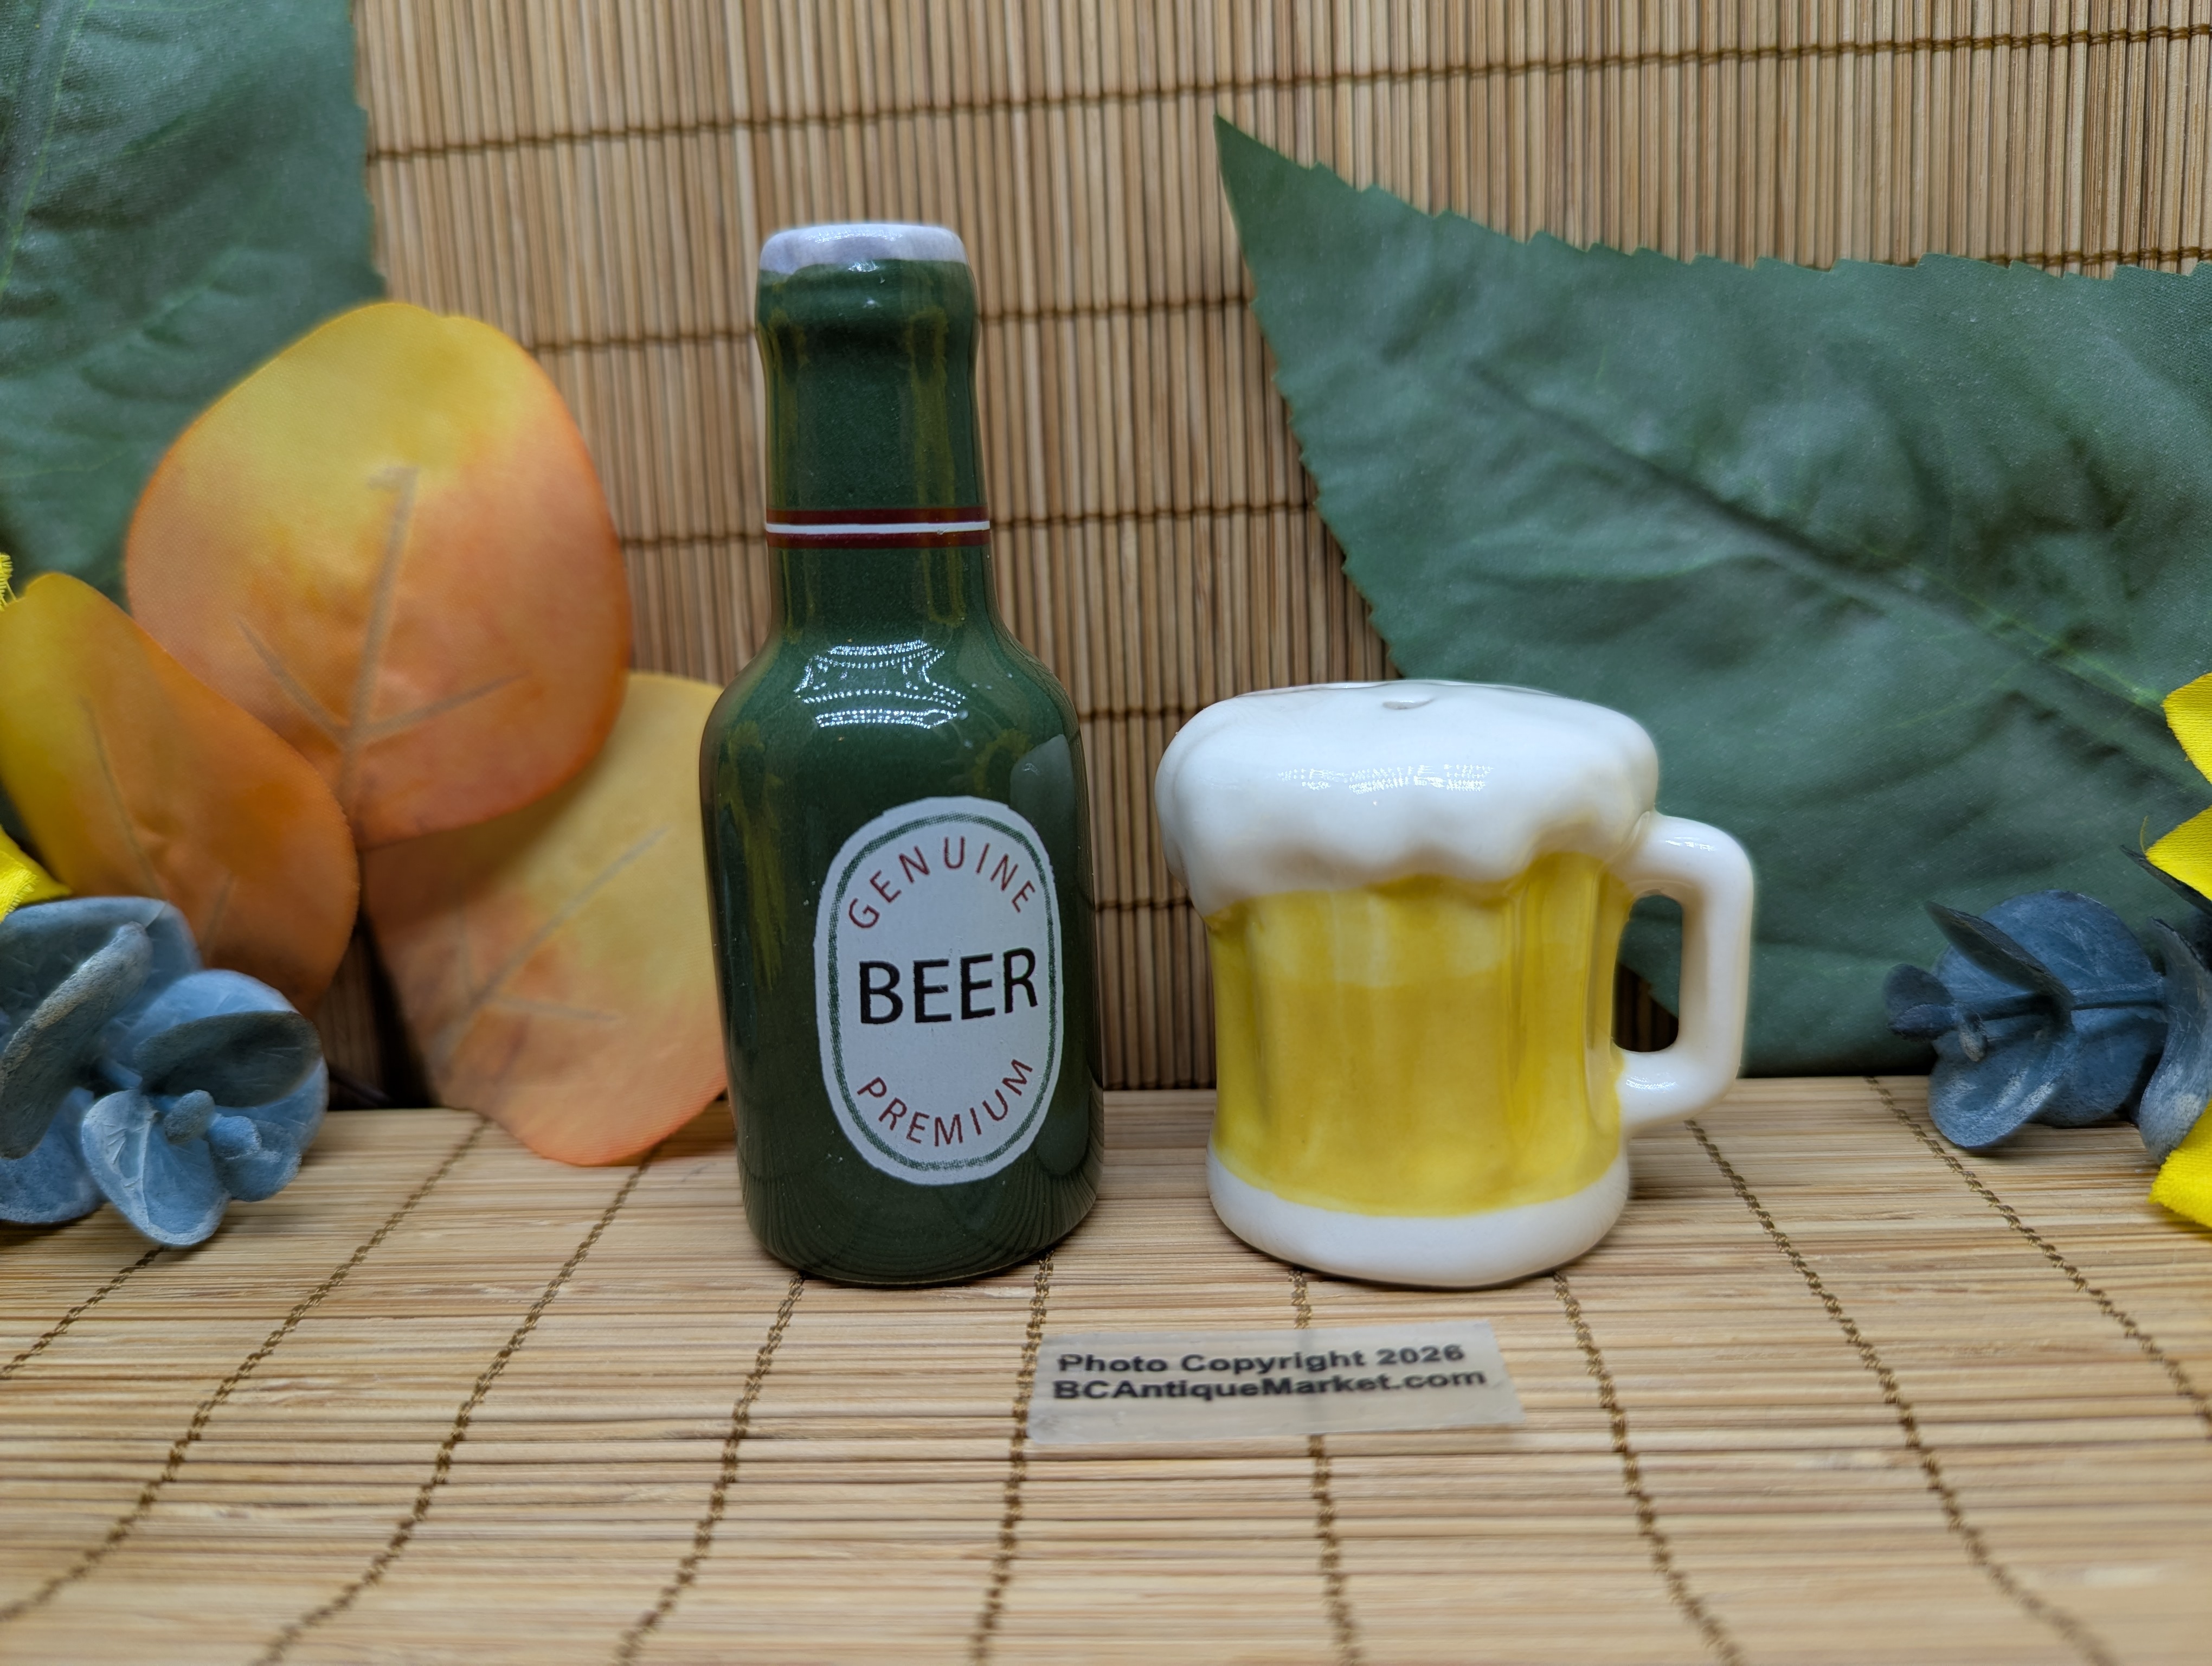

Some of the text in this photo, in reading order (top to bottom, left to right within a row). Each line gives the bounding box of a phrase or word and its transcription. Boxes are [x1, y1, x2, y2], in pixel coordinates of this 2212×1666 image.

[848, 836, 1036, 929] GENUINE
[859, 946, 1038, 1024] BEER
[857, 1058, 1033, 1147] PREMIUM
[1053, 1369, 1487, 1402] BCAntiqueMarket.com
[1058, 1343, 1465, 1377] Photo Copyright 2026
